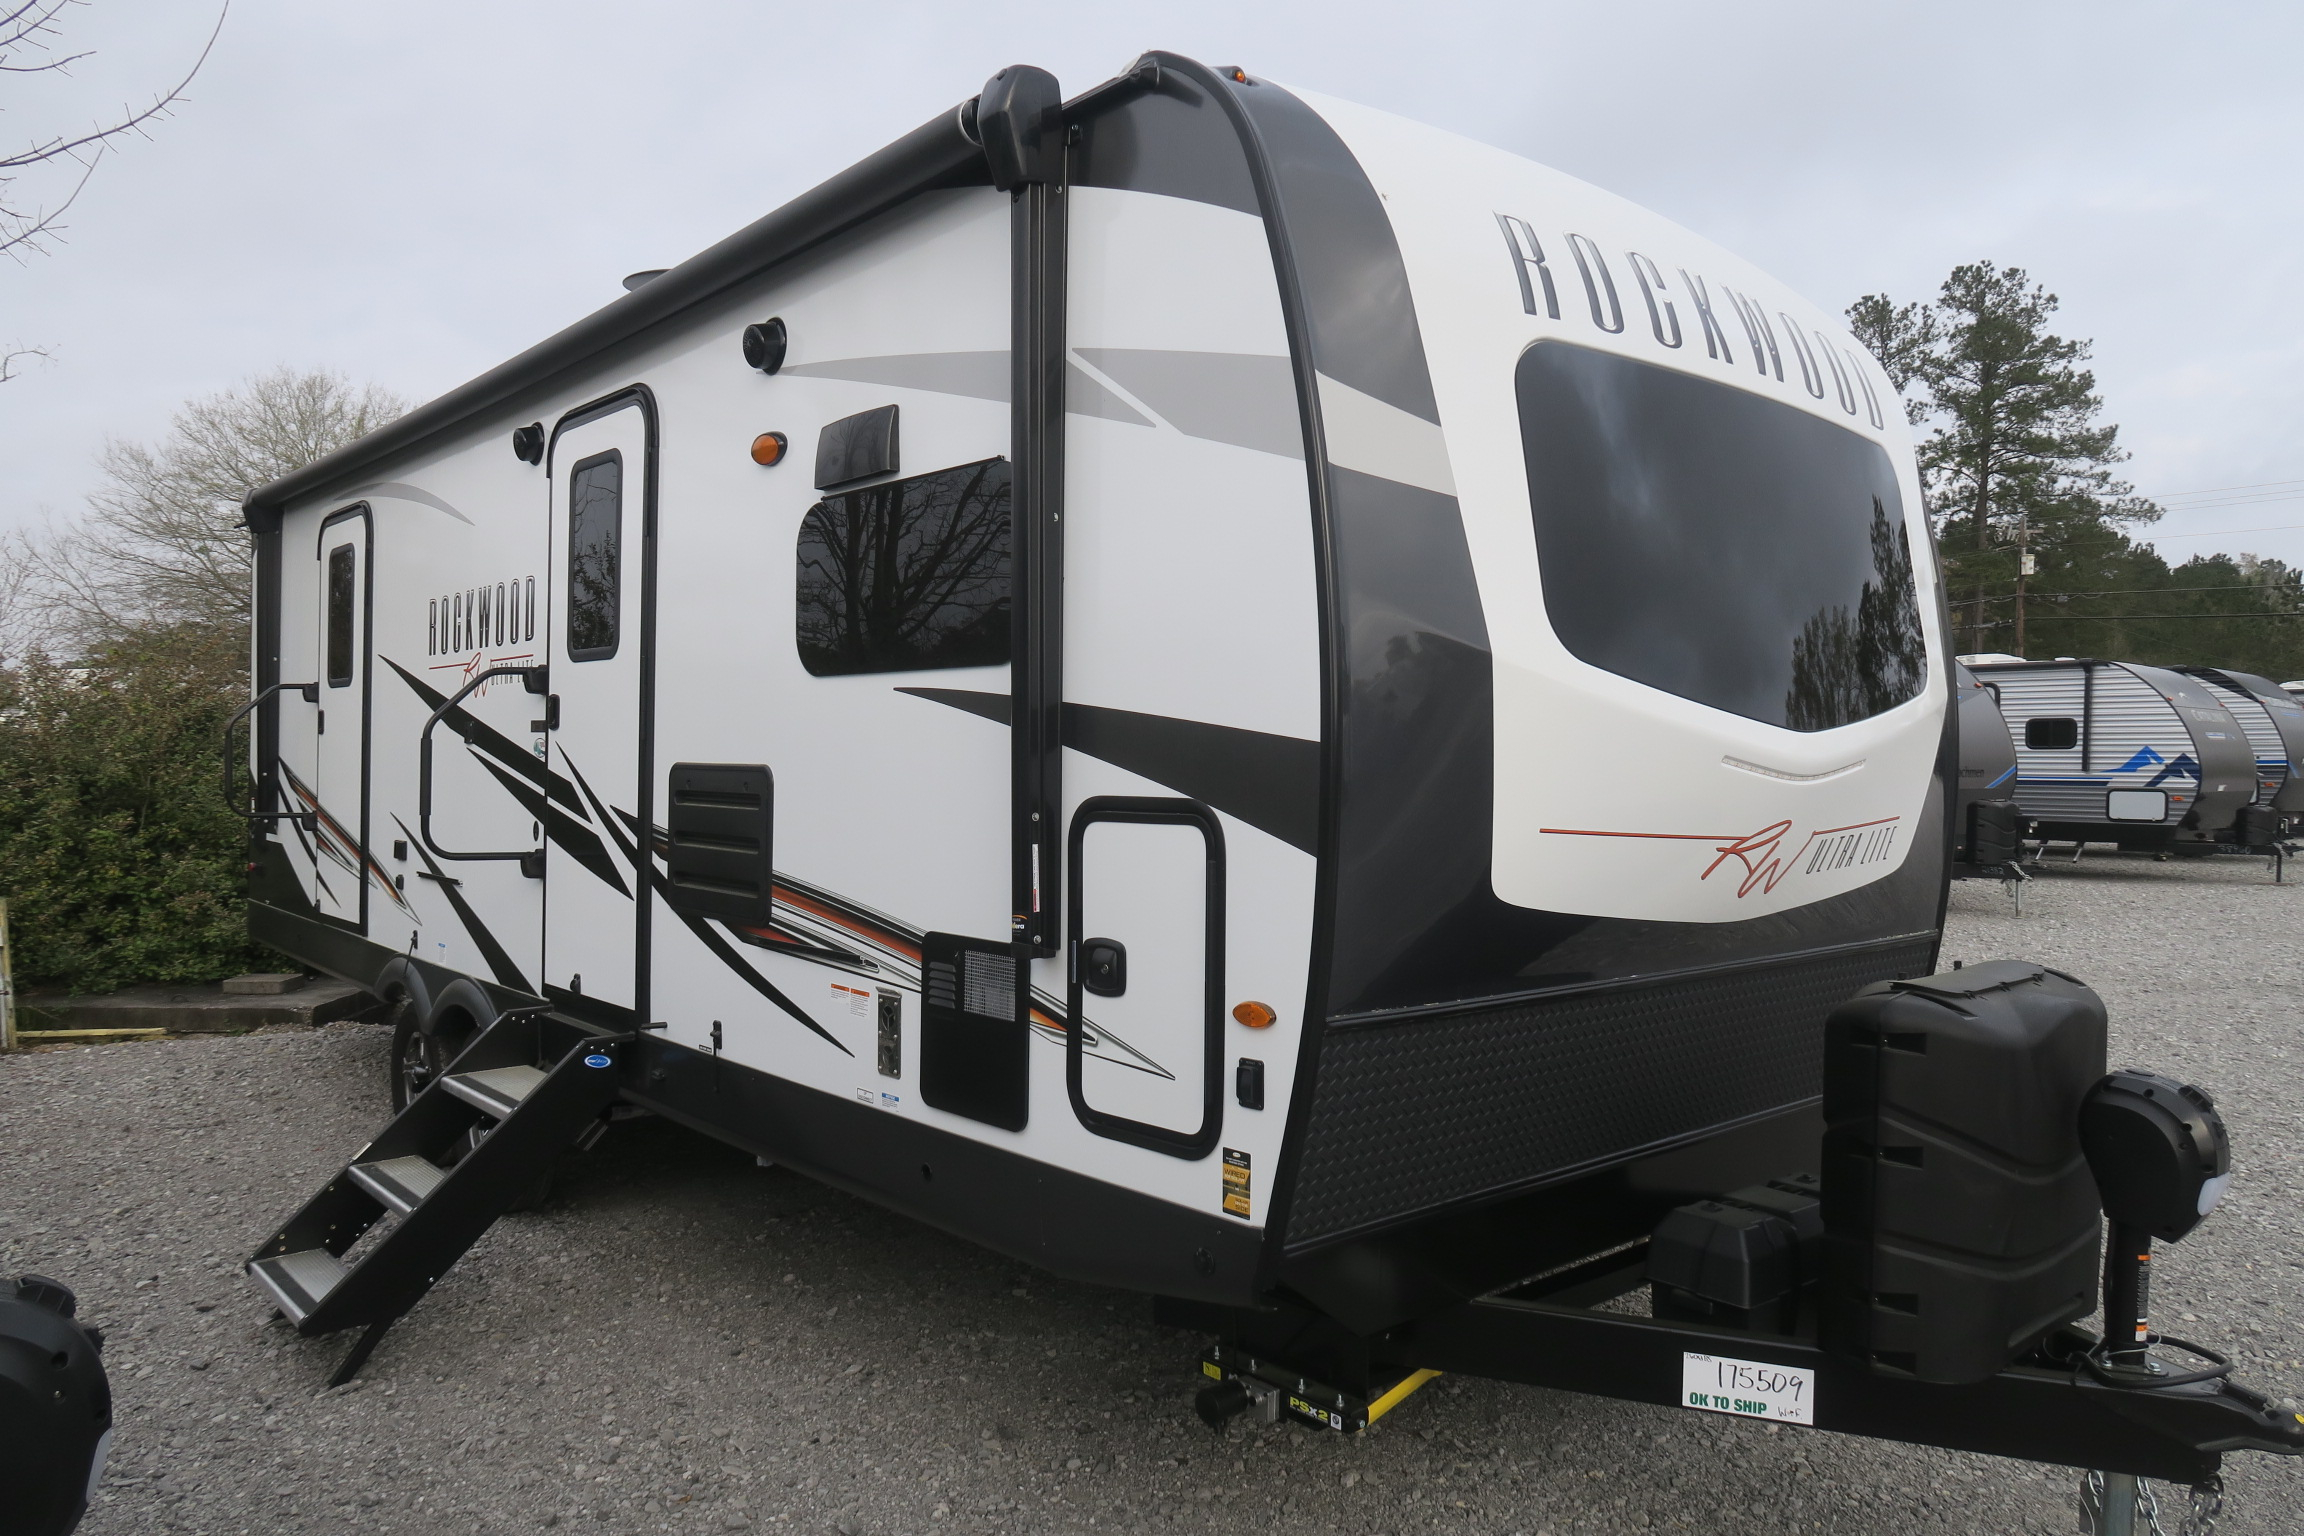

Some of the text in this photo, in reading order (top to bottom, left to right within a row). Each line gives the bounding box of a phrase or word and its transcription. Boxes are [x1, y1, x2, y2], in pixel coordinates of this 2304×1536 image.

[1492, 209, 1884, 431] ROCKWOOD
[428, 575, 536, 656] ROCKWOOD
[1805, 832, 1863, 875] ULTRA
[1860, 825, 1898, 865] LITE
[1689, 1391, 1768, 1415] OK TO SHIP
[1718, 1361, 1803, 1402] 175509
